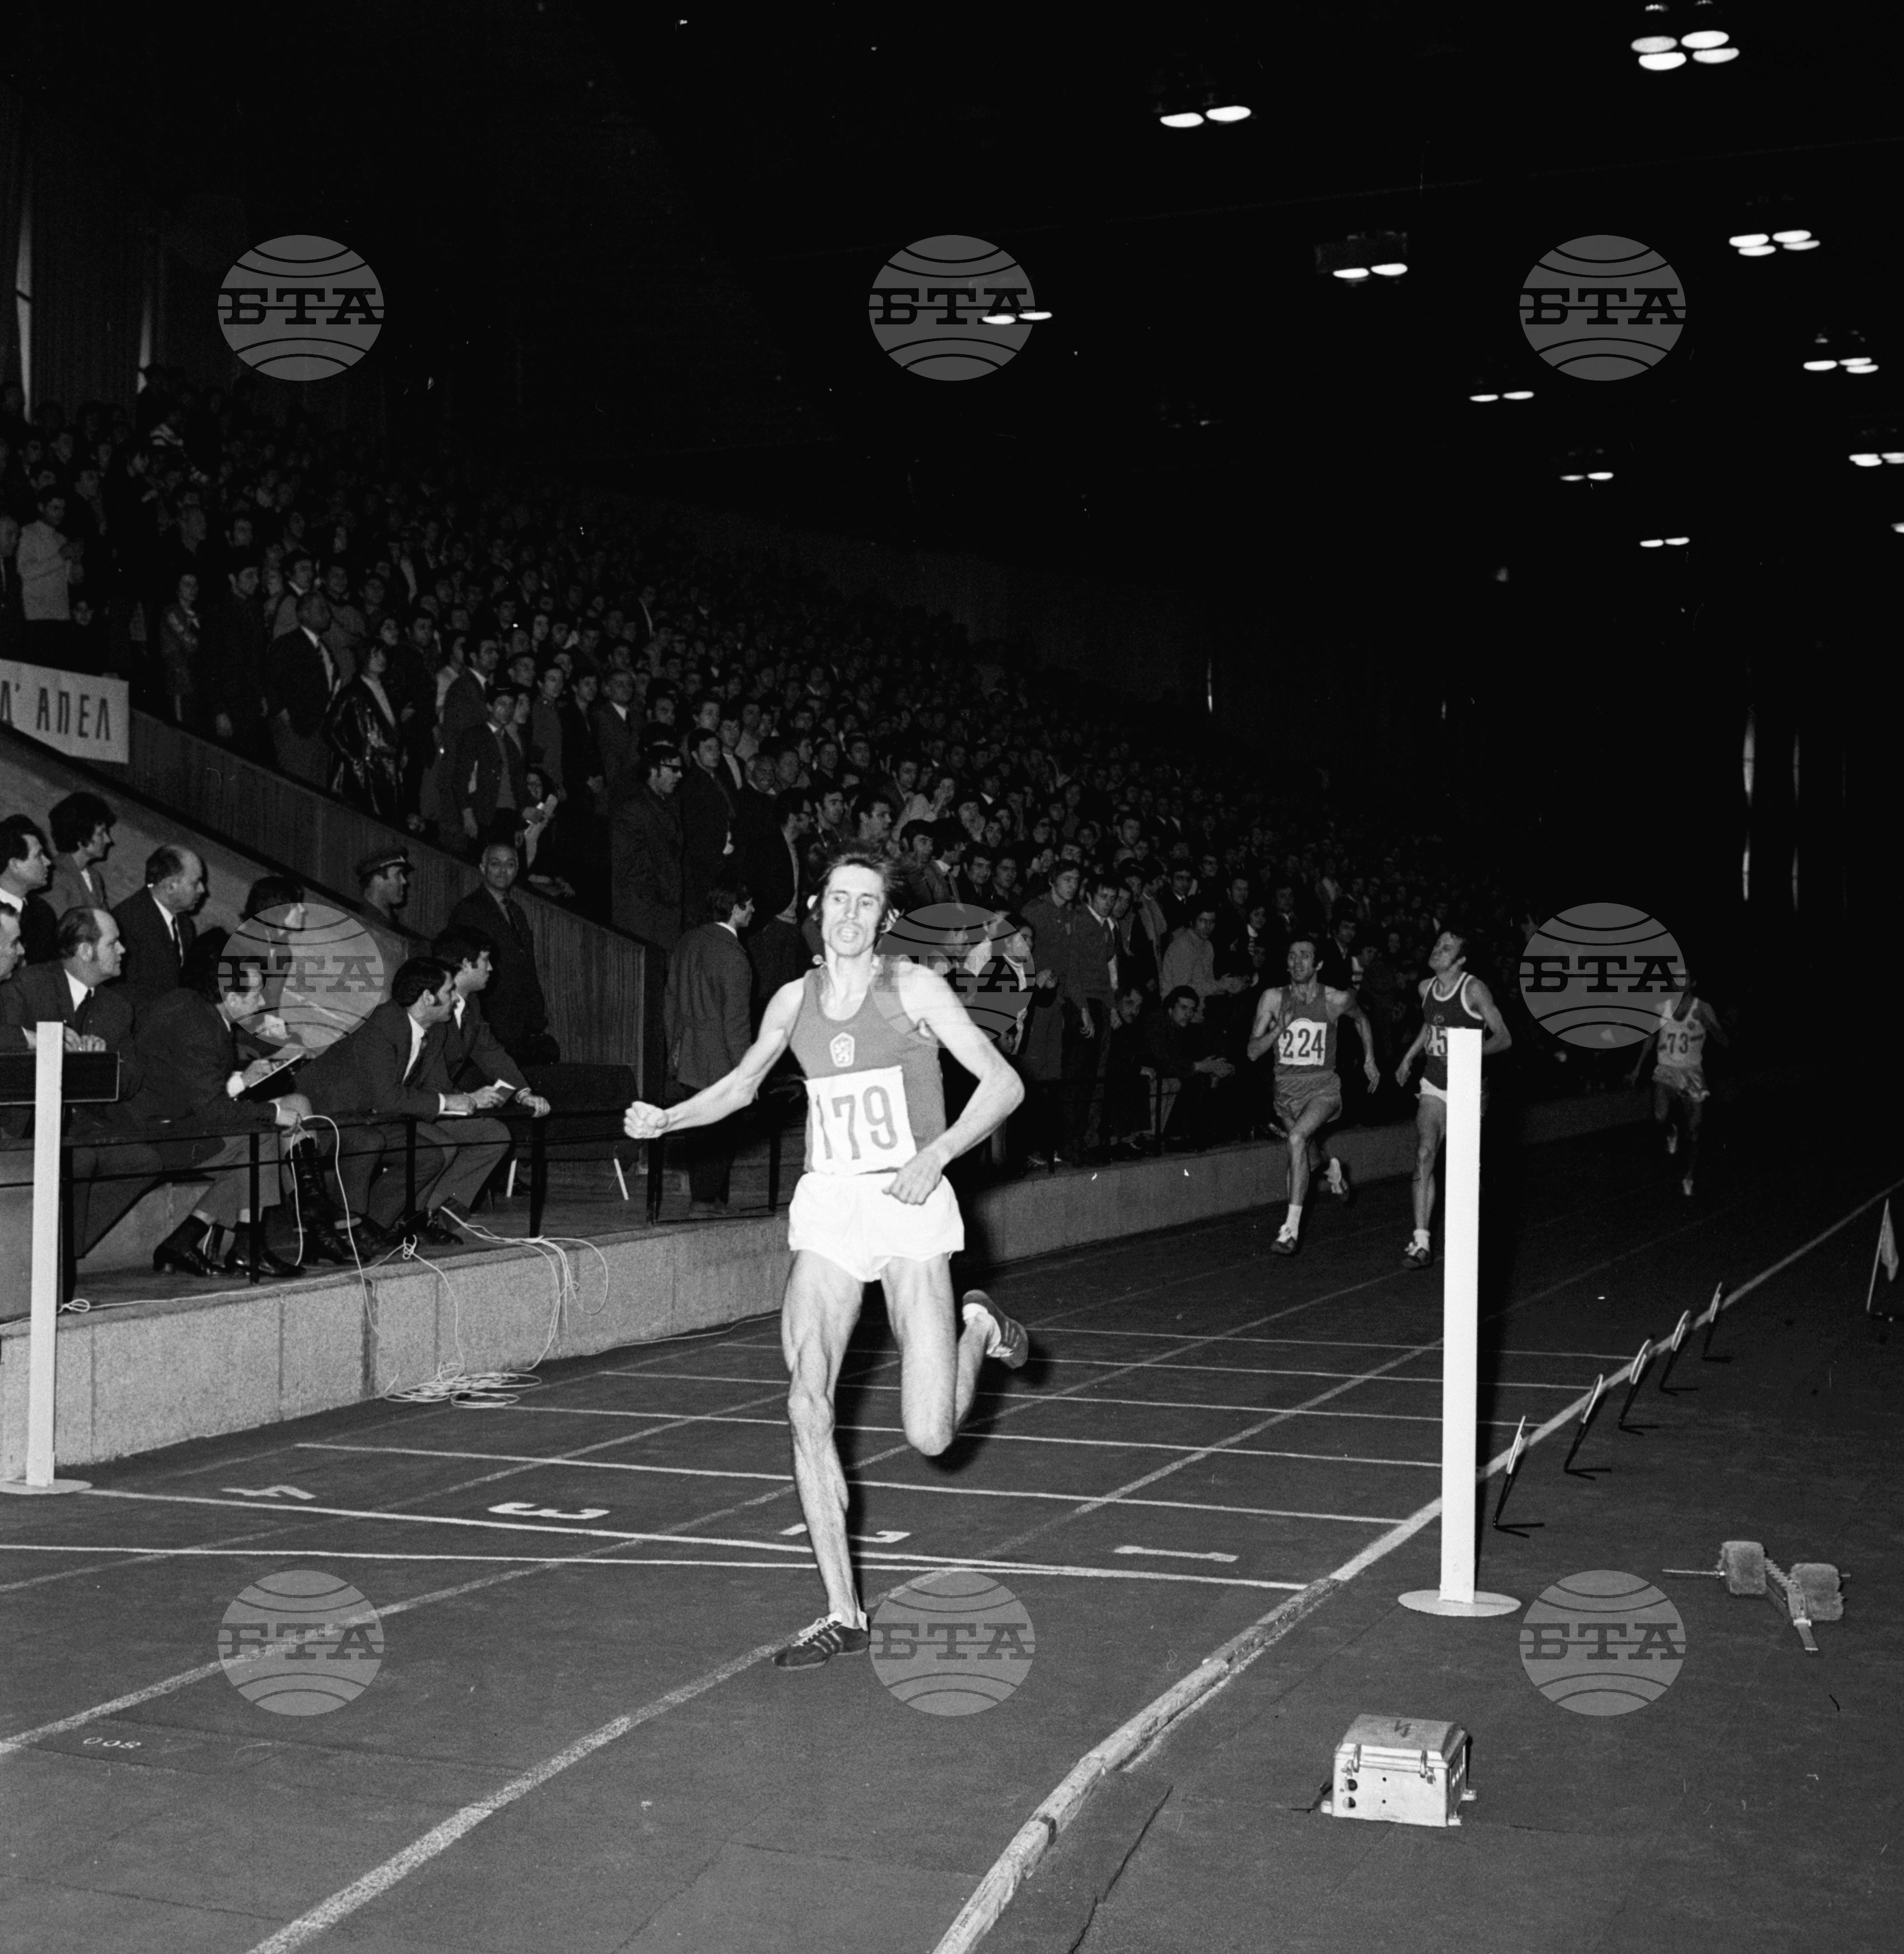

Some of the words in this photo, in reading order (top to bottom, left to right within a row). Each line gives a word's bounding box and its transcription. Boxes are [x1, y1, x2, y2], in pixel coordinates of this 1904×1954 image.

[1283, 1028, 1323, 1059] 224
[1426, 1025, 1447, 1055] 25
[815, 1085, 898, 1160] 179
[487, 1502, 610, 1519] 3
